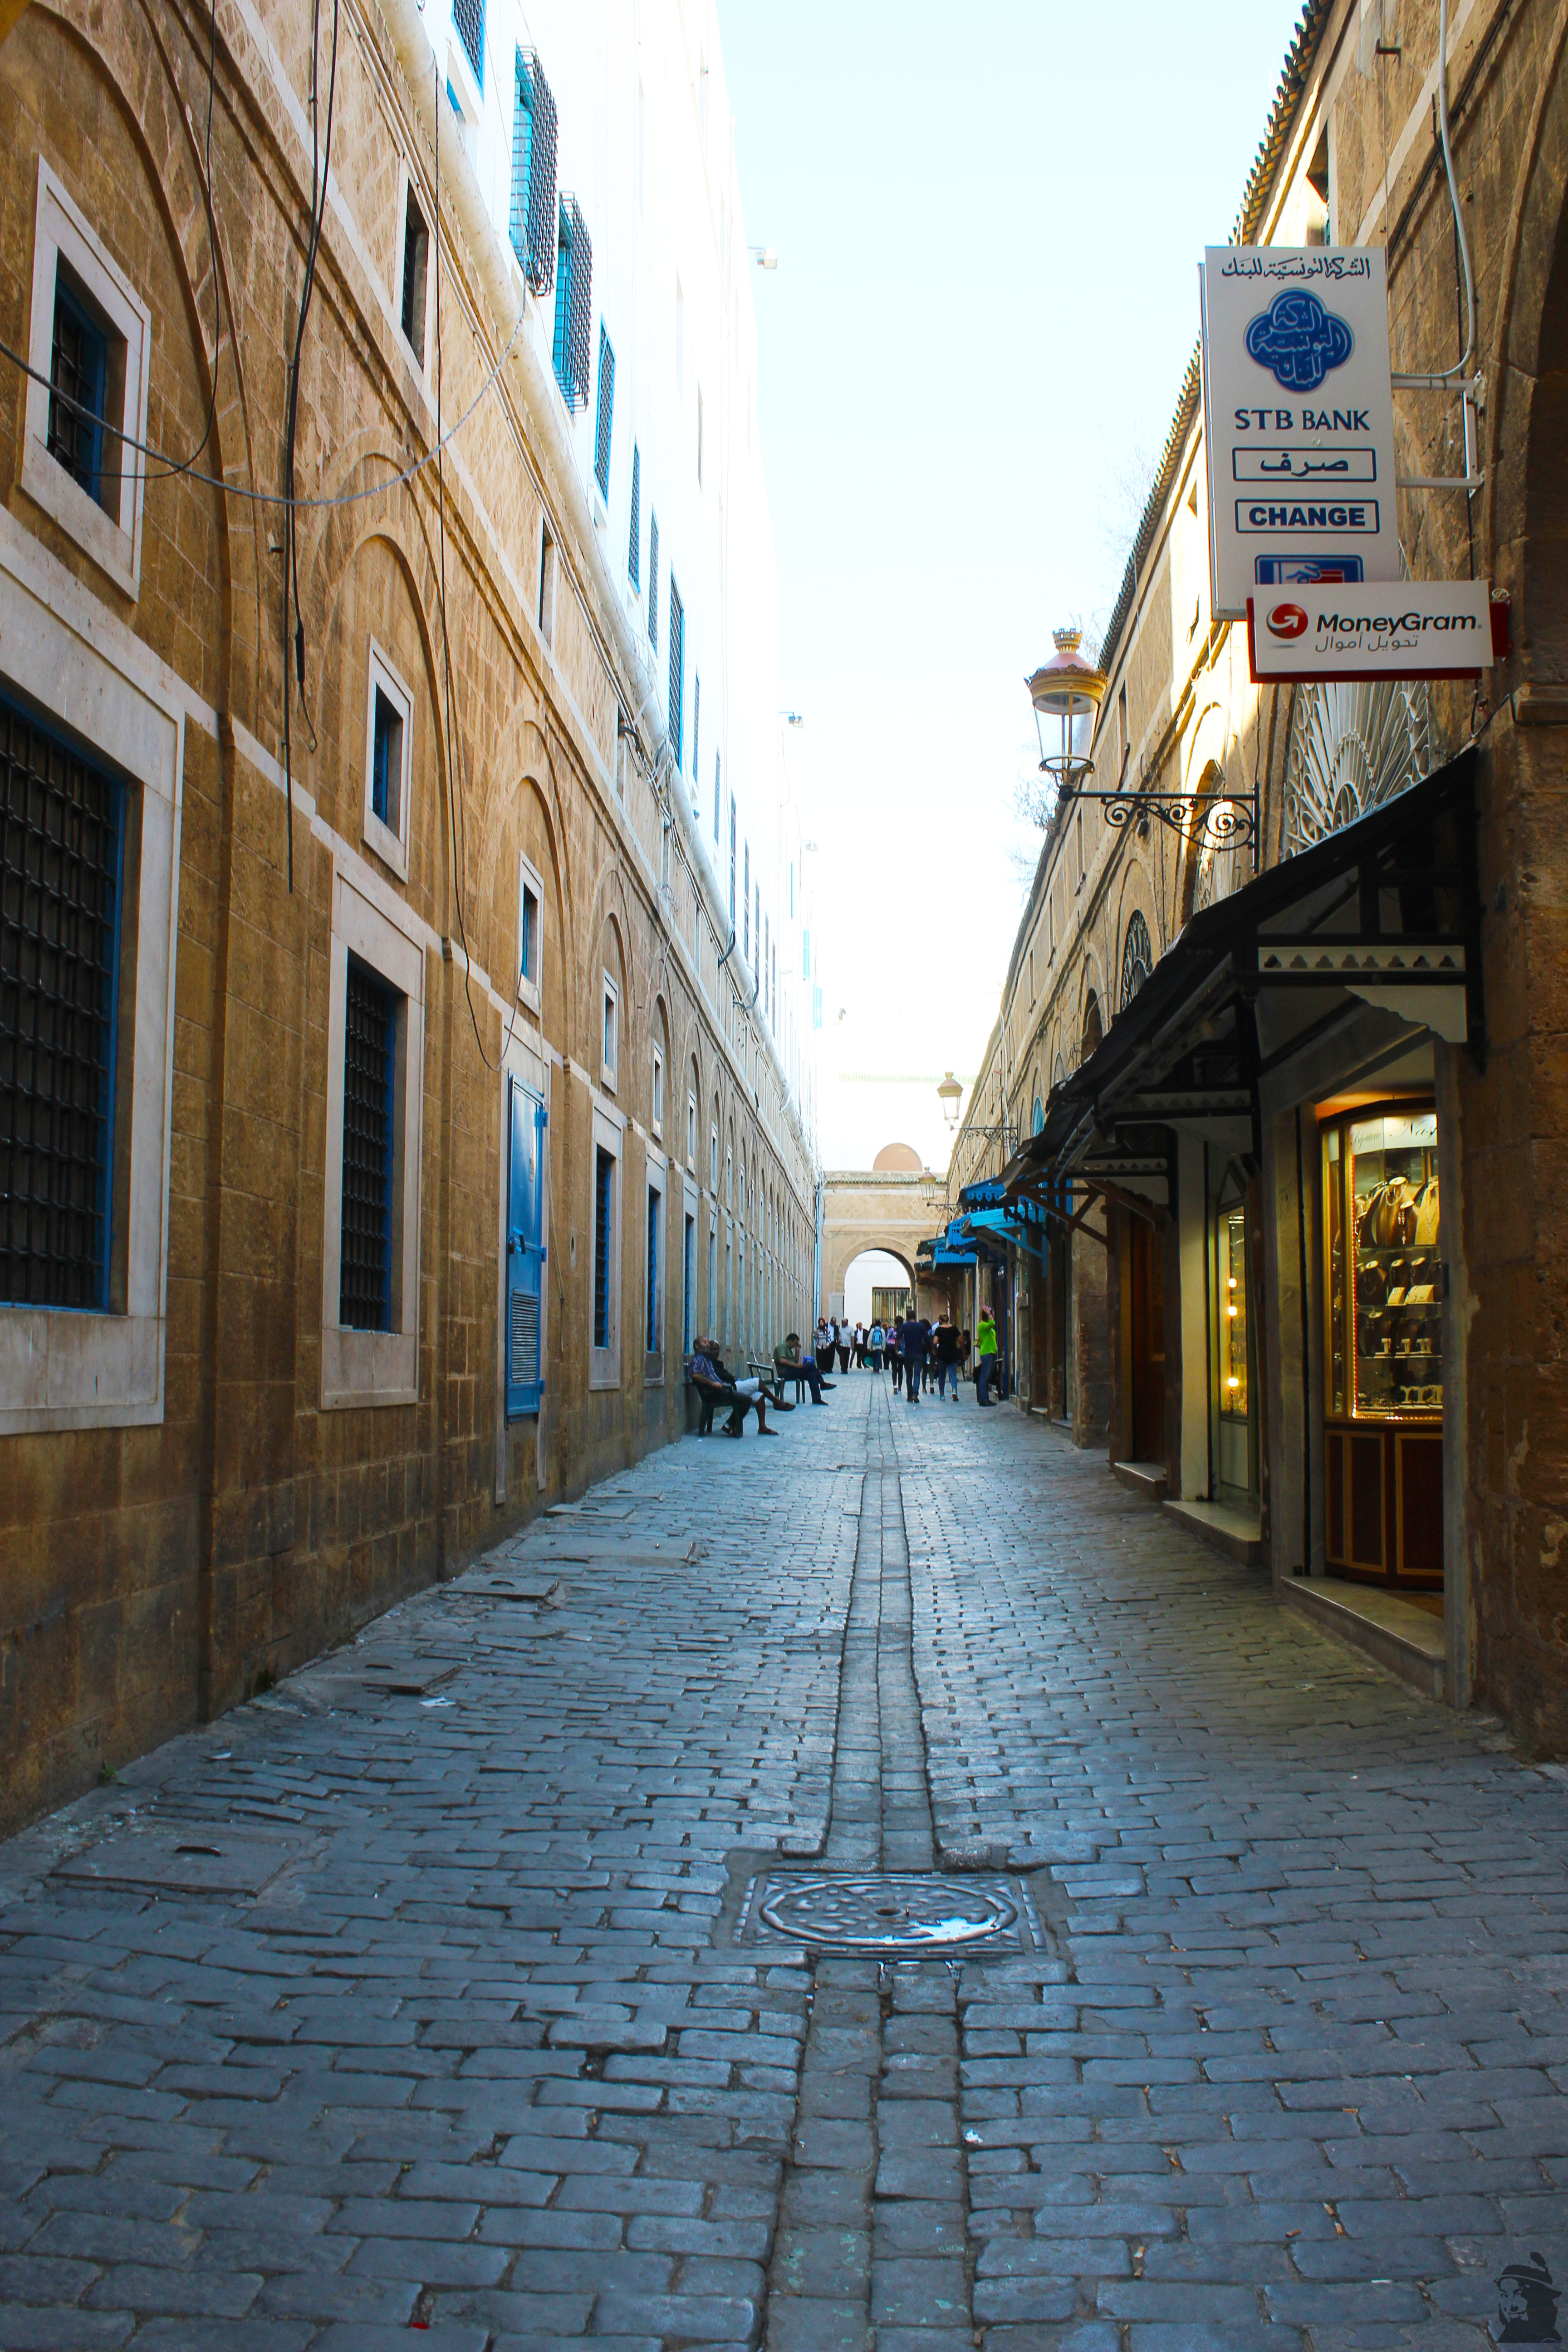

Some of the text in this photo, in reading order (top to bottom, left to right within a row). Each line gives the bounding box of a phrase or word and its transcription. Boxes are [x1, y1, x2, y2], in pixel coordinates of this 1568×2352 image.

[1235, 408, 1371, 431] STB BANK
[1260, 452, 1349, 477] صرف
[1249, 506, 1366, 526] CHANGE
[1316, 612, 1476, 637] MoneyGram
[1315, 632, 1419, 652] تحويل أموال
